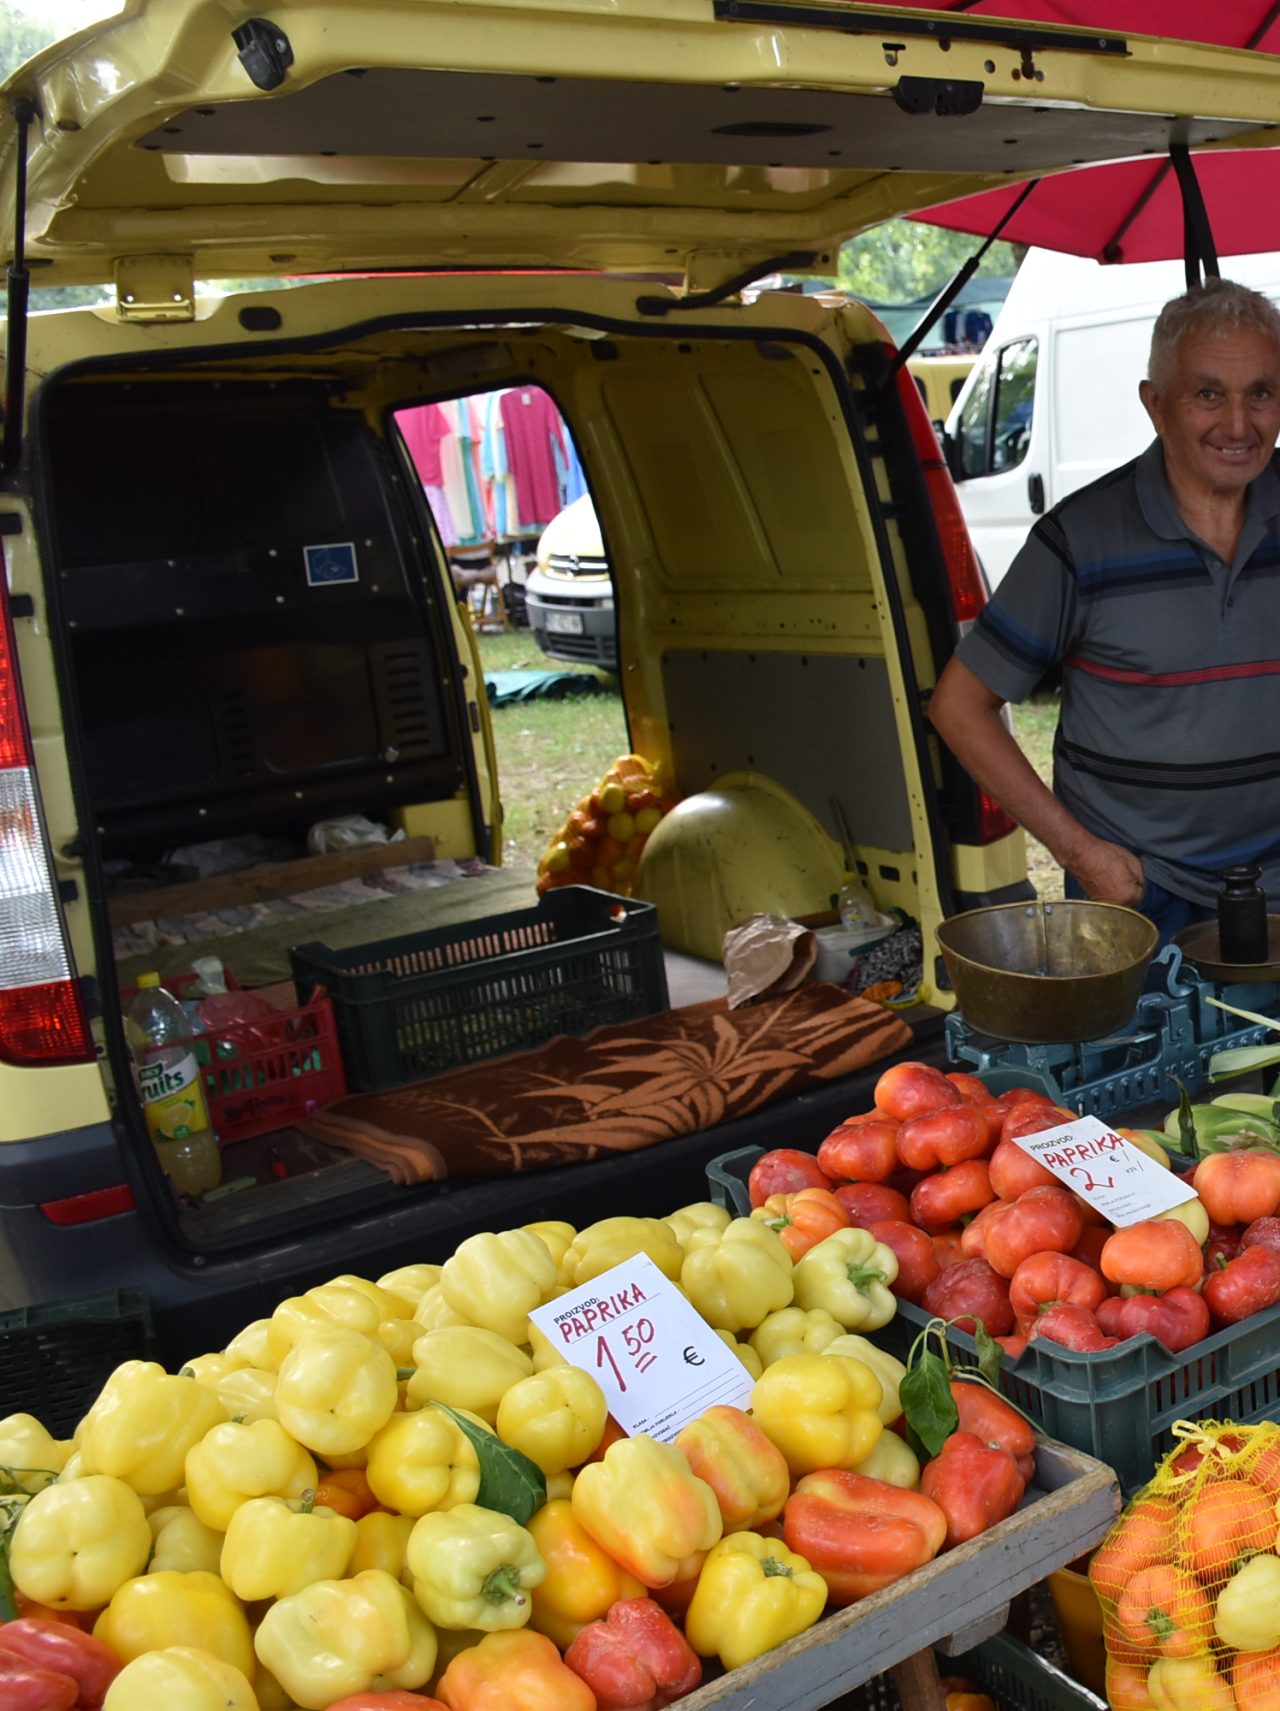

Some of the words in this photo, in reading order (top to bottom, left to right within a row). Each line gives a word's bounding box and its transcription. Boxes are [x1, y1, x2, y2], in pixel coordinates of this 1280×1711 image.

[141, 1071, 184, 1100] ruits
[1043, 1132, 1125, 1169] PAPRIKA
[1069, 1167, 1114, 1192] 2
[553, 1296, 600, 1325] PROIZVOD:
[559, 1283, 647, 1343] PAPRIKA
[683, 1346, 705, 1366] €
